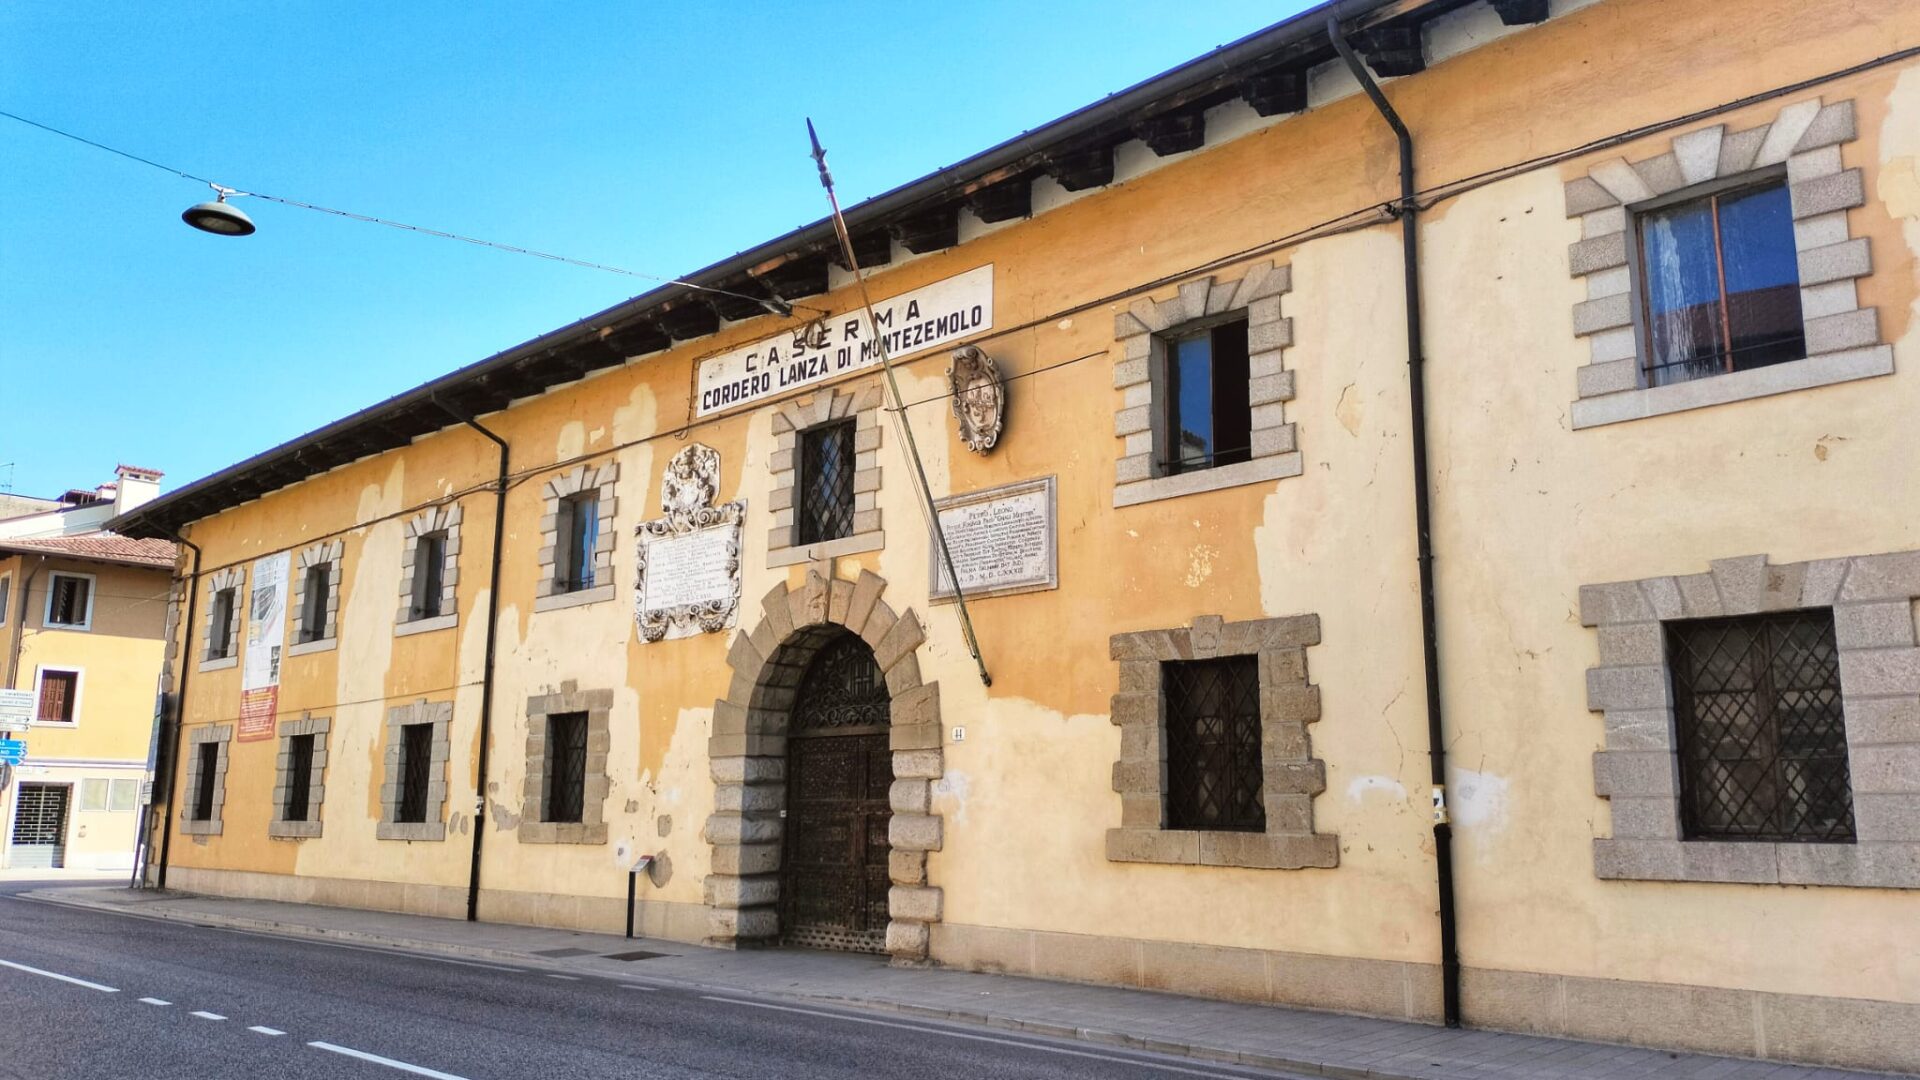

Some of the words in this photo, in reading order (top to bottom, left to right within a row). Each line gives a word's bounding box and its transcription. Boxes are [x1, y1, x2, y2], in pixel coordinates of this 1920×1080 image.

[703, 372, 770, 410] CORDERO
[780, 354, 828, 388] LANZA
[838, 346, 851, 369] DI
[860, 305, 982, 362] MONTEZEMOLO
[746, 300, 920, 373] CASERMA
